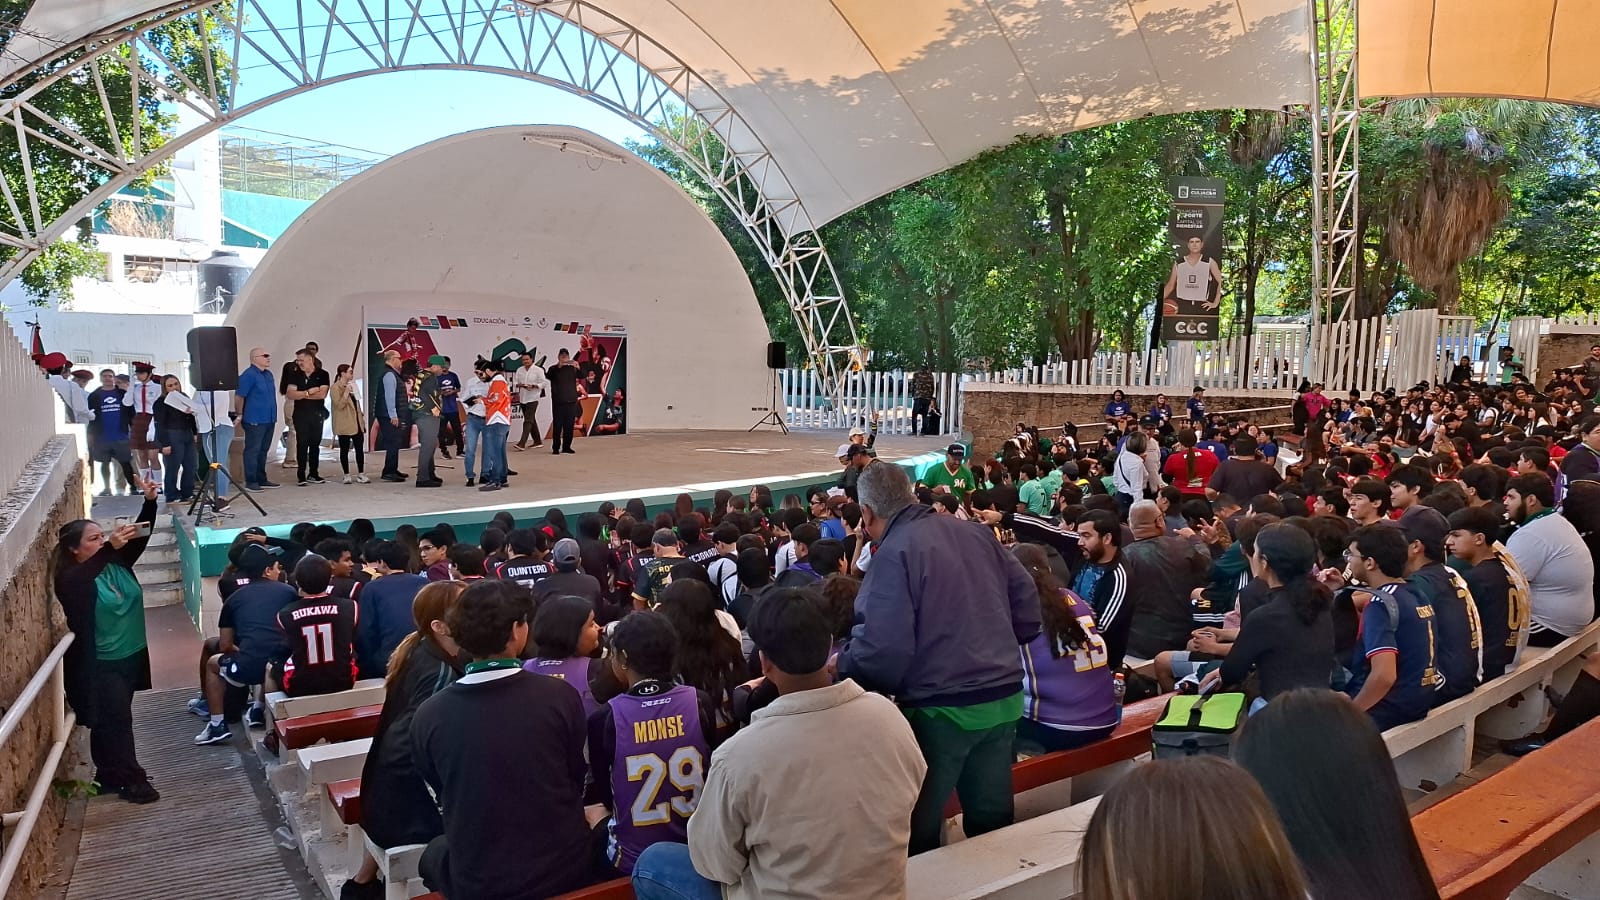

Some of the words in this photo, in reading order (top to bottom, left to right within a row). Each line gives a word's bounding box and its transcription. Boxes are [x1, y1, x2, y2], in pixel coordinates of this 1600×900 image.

[1174, 321, 1208, 335] CCC
[507, 564, 548, 577] QUINTERO
[291, 604, 339, 621] RUKAWA
[301, 622, 335, 665] 11
[633, 714, 685, 744] MONSE
[625, 745, 705, 827] 29
